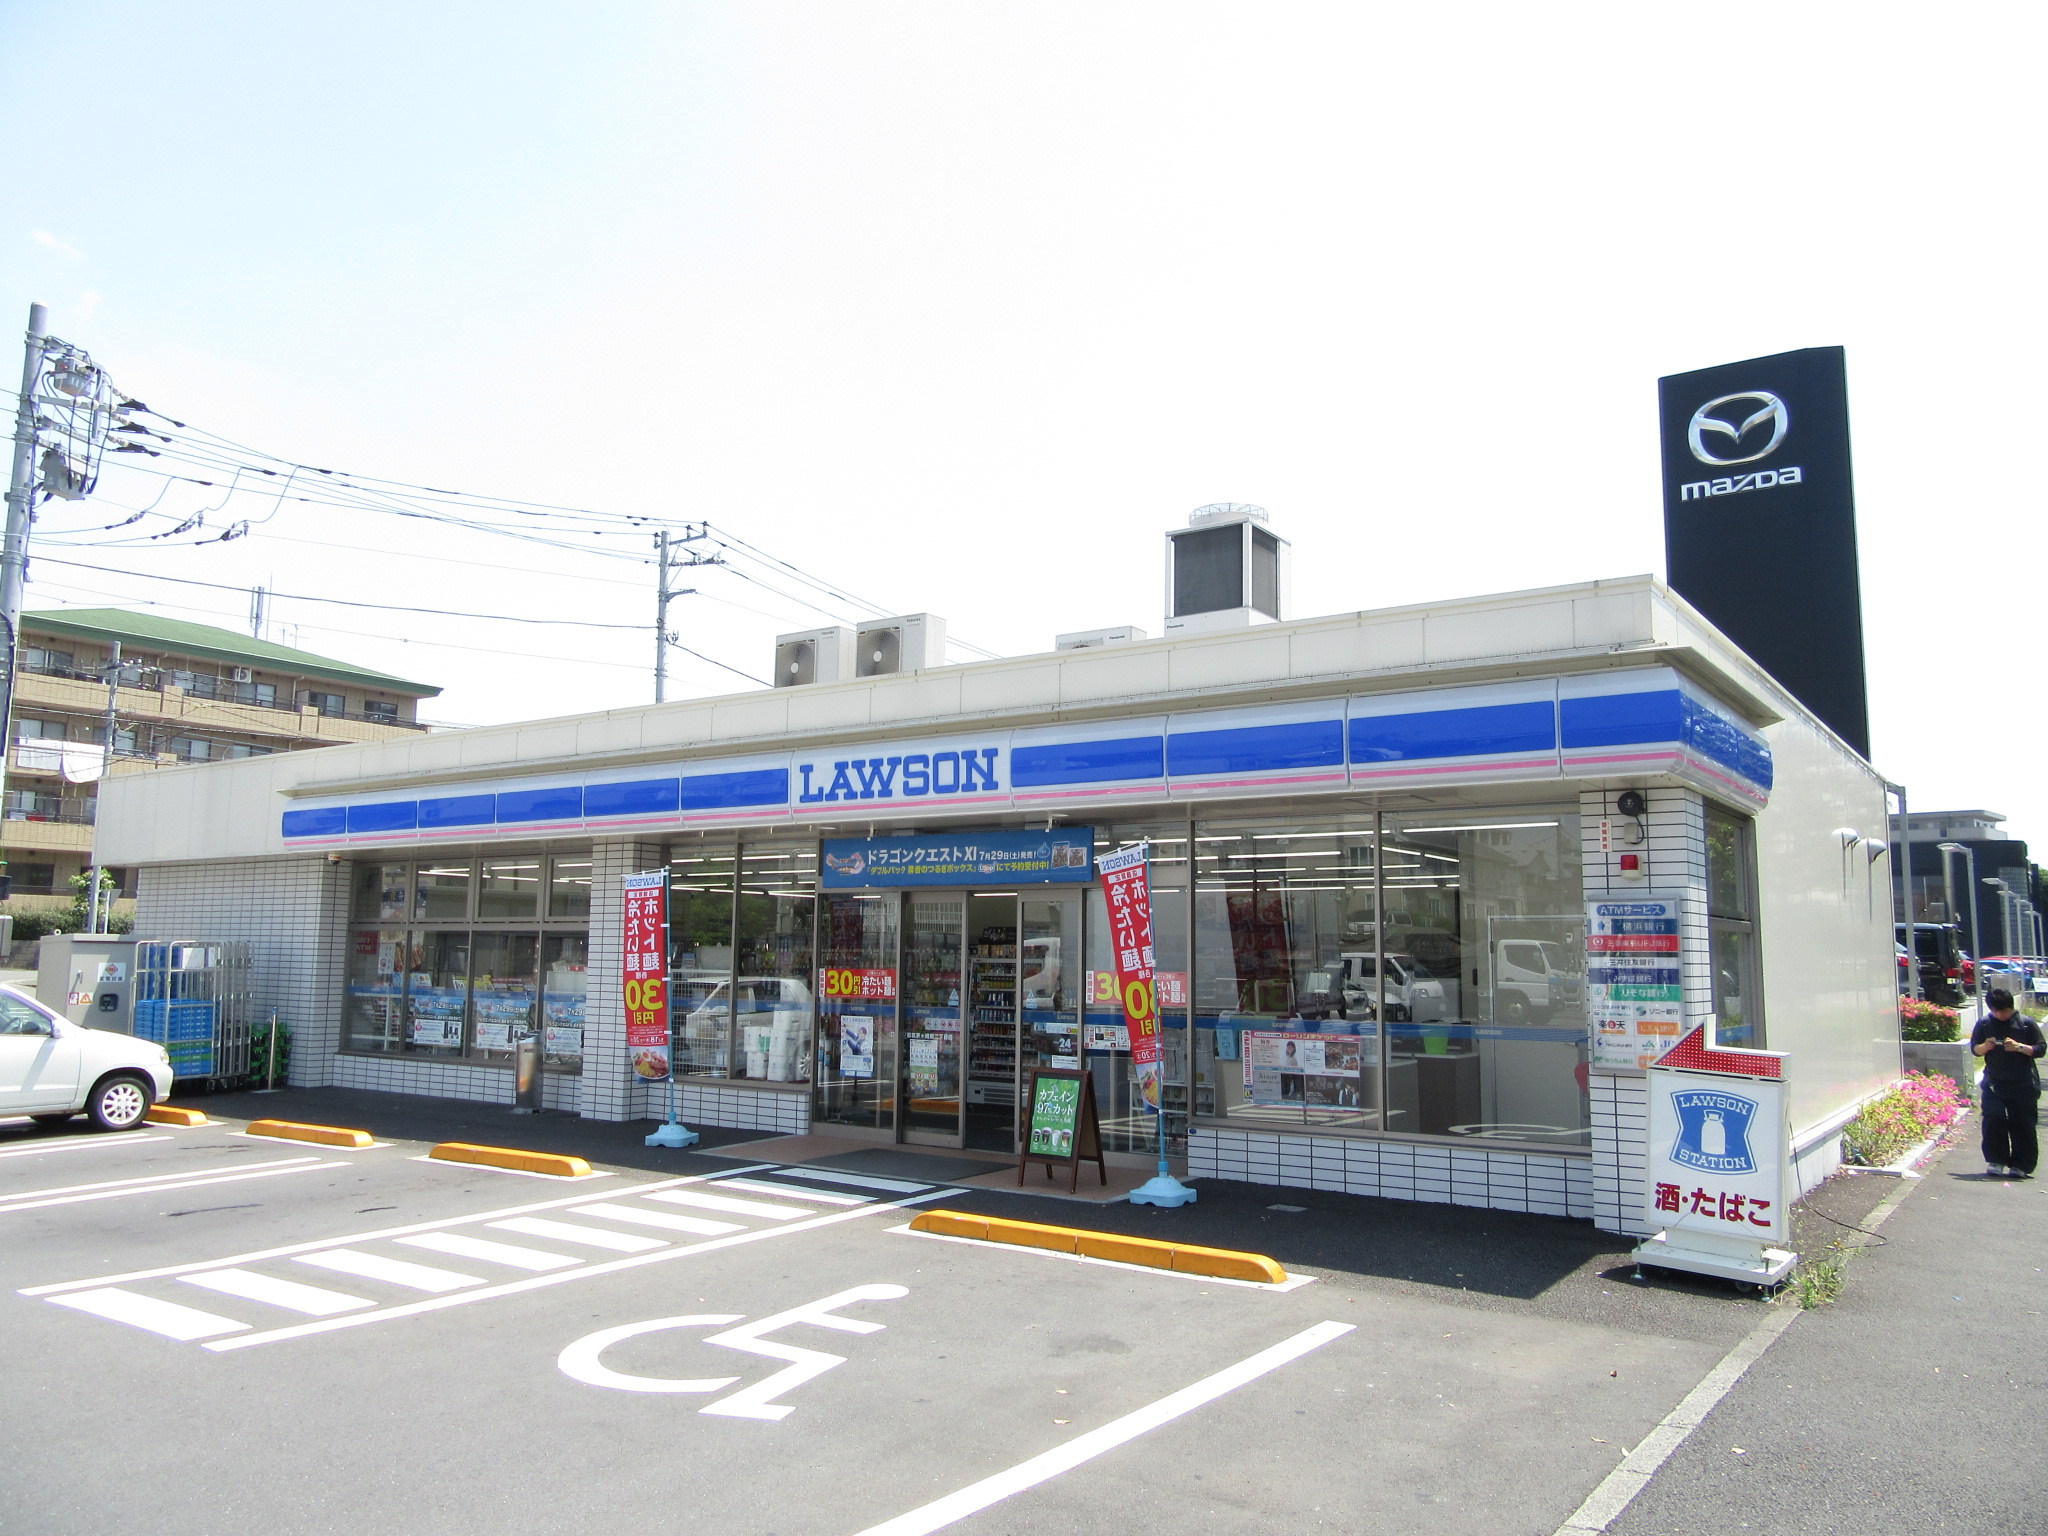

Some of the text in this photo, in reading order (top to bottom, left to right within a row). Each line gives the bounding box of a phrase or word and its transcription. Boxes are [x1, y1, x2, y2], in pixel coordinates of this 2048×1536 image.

[1681, 466, 1802, 501] mazda
[799, 748, 999, 803] LAWSON
[867, 846, 977, 865] ドラゴンクエストXI
[1600, 905, 1662, 915] ATMサービス
[1622, 922, 1665, 931] 横浜銀行
[1609, 958, 1655, 967] 三井住友銀行
[826, 970, 854, 995] 30
[861, 976, 892, 986] 冷たい麺
[862, 986, 892, 996] ホット麺
[1622, 988, 1665, 997] りそな銀行
[1059, 1037, 1071, 1049] 24
[1039, 1088, 1075, 1102] カフェイン
[1679, 1095, 1750, 1115] LAWSON
[1679, 1148, 1748, 1169] STATION
[1654, 1181, 1772, 1227] 酒・たばこ
